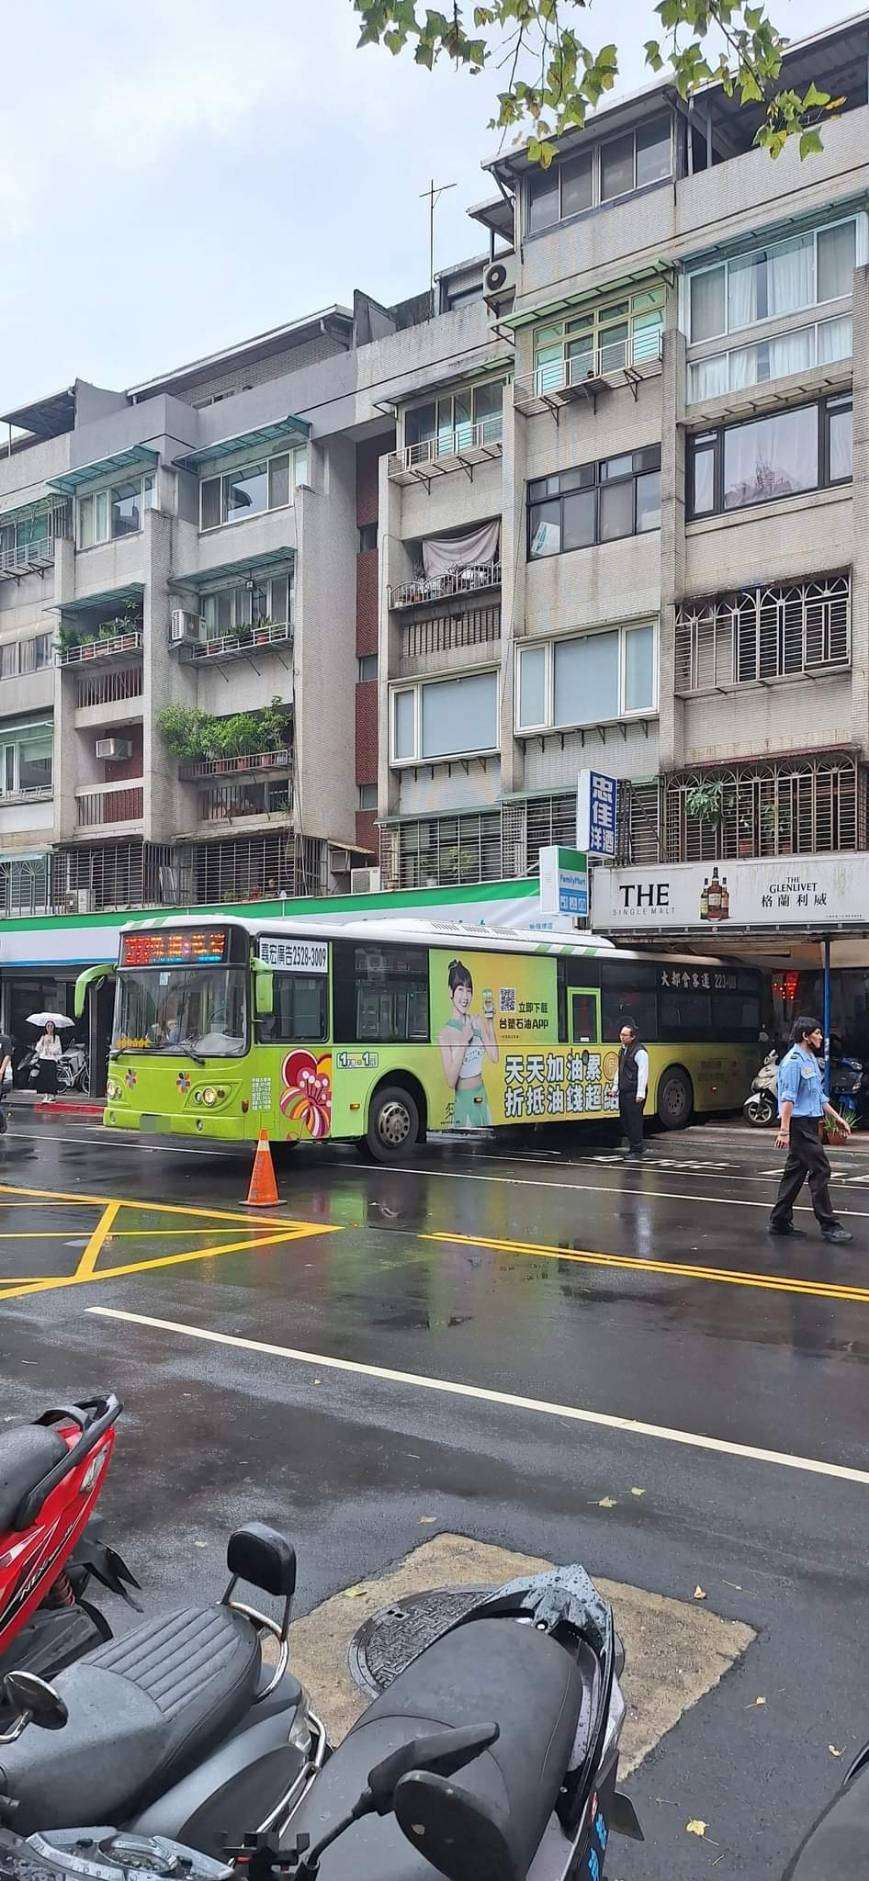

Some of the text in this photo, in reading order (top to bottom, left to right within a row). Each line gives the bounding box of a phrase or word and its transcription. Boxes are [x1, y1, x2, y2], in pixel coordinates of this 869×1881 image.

[560, 874, 586, 886] FamilyMart
[786, 876, 801, 884] THE
[769, 882, 818, 893] GLENLIVET
[619, 883, 670, 907] THE
[761, 893, 828, 908] 格蘭利威
[613, 907, 675, 916] SINGLE MALT
